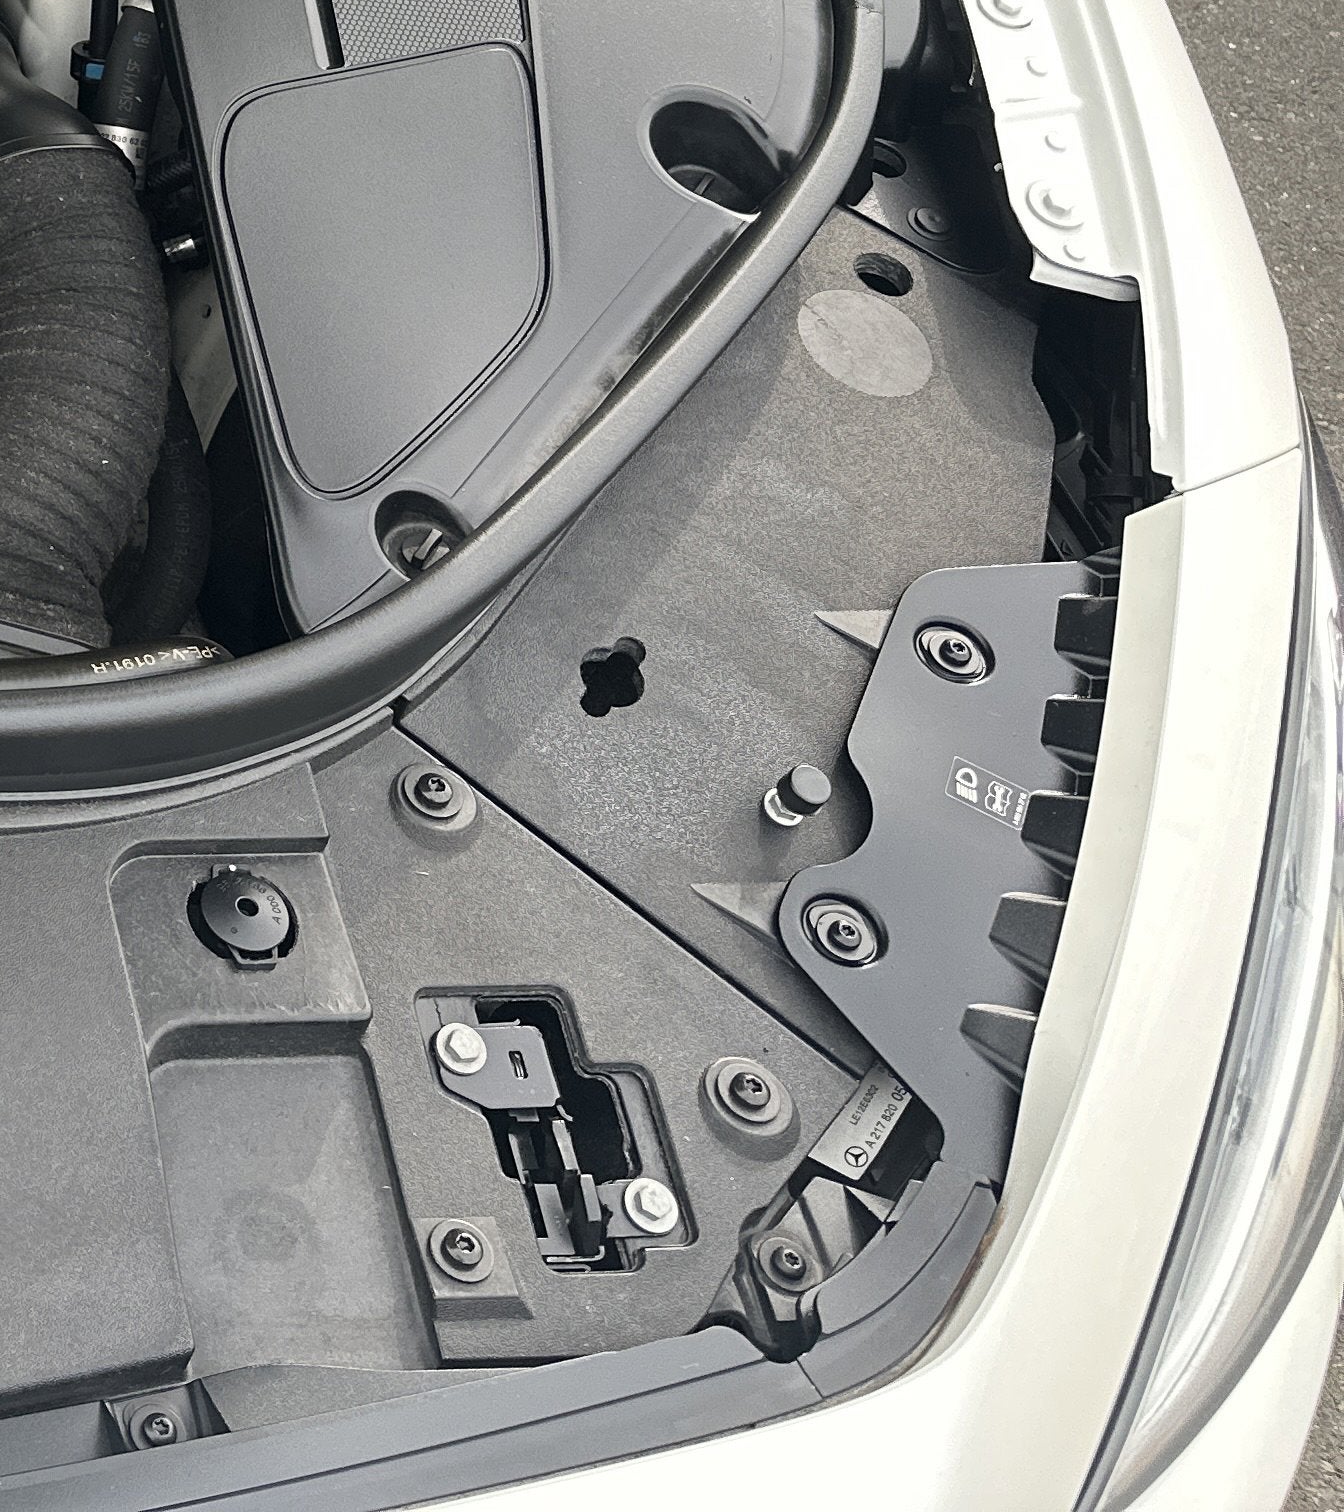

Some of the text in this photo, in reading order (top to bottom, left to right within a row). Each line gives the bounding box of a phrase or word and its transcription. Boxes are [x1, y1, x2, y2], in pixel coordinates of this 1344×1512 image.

[891, 1085, 908, 1103] 05
[870, 1121, 886, 1141] 217
[865, 1140, 876, 1149] A
